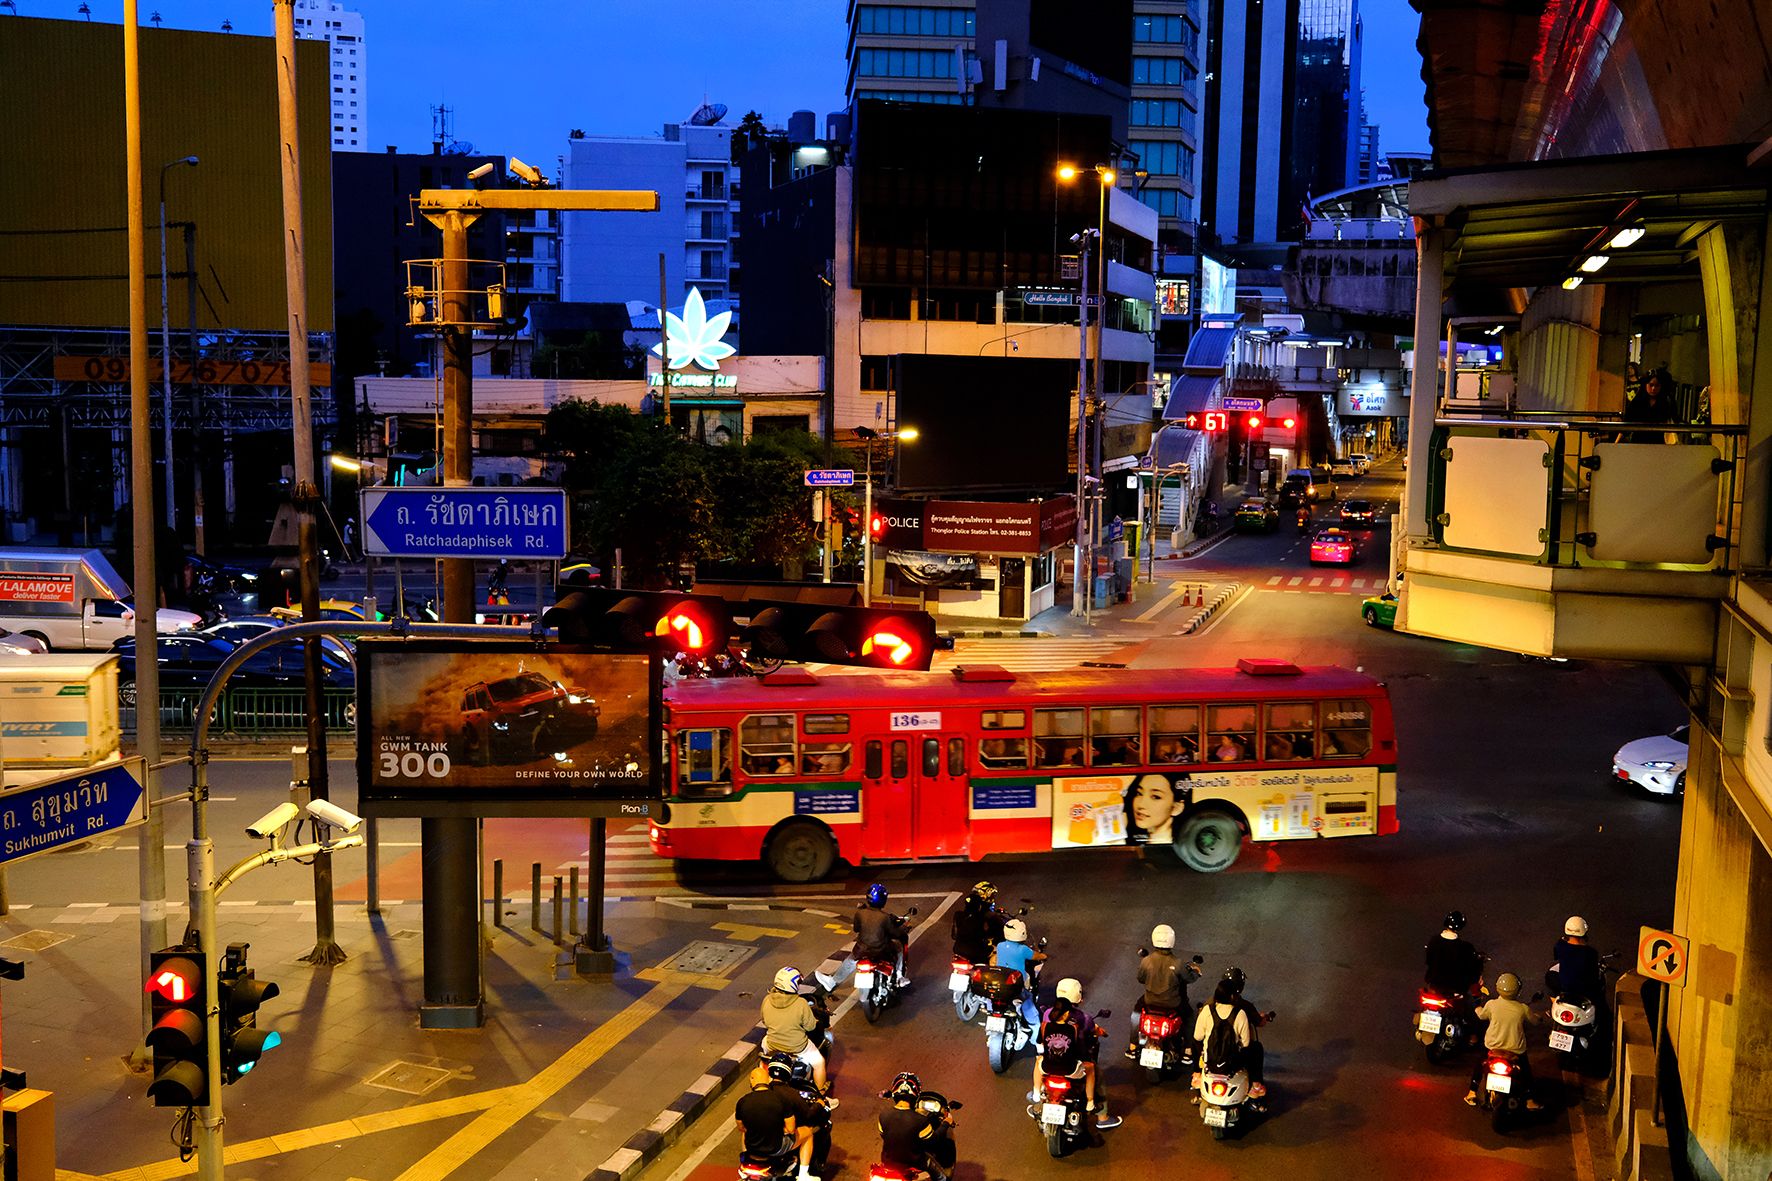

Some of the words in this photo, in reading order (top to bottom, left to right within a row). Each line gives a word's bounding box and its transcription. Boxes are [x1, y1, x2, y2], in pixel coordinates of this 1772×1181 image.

[1028, 294, 1046, 303] Hello
[84, 358, 131, 382] 09
[1205, 412, 1226, 431] 67
[396, 505, 416, 525] ถ.
[425, 494, 557, 527] รัชดาภิเษก
[881, 516, 919, 529] POLICE
[930, 527, 953, 535] Thonglor
[970, 528, 989, 536] Station
[405, 533, 513, 550] Ratchadaphisek
[525, 535, 550, 549] Rd.
[3, 581, 73, 593] LALAMOVE
[13, 591, 39, 600] deliver
[39, 592, 61, 600] faster
[893, 714, 919, 727] 136
[380, 742, 410, 752] GWM
[414, 742, 448, 752] TANK
[379, 752, 451, 778] 300
[515, 770, 550, 778] DEFINE
[553, 770, 580, 778] YOUR
[583, 770, 606, 778] OWN
[608, 770, 643, 778] WORLD
[3, 810, 21, 830] ถ.
[31, 779, 108, 828] สุขุมวิท
[5, 823, 75, 855] Sukhumvit
[87, 814, 109, 830] Rd.
